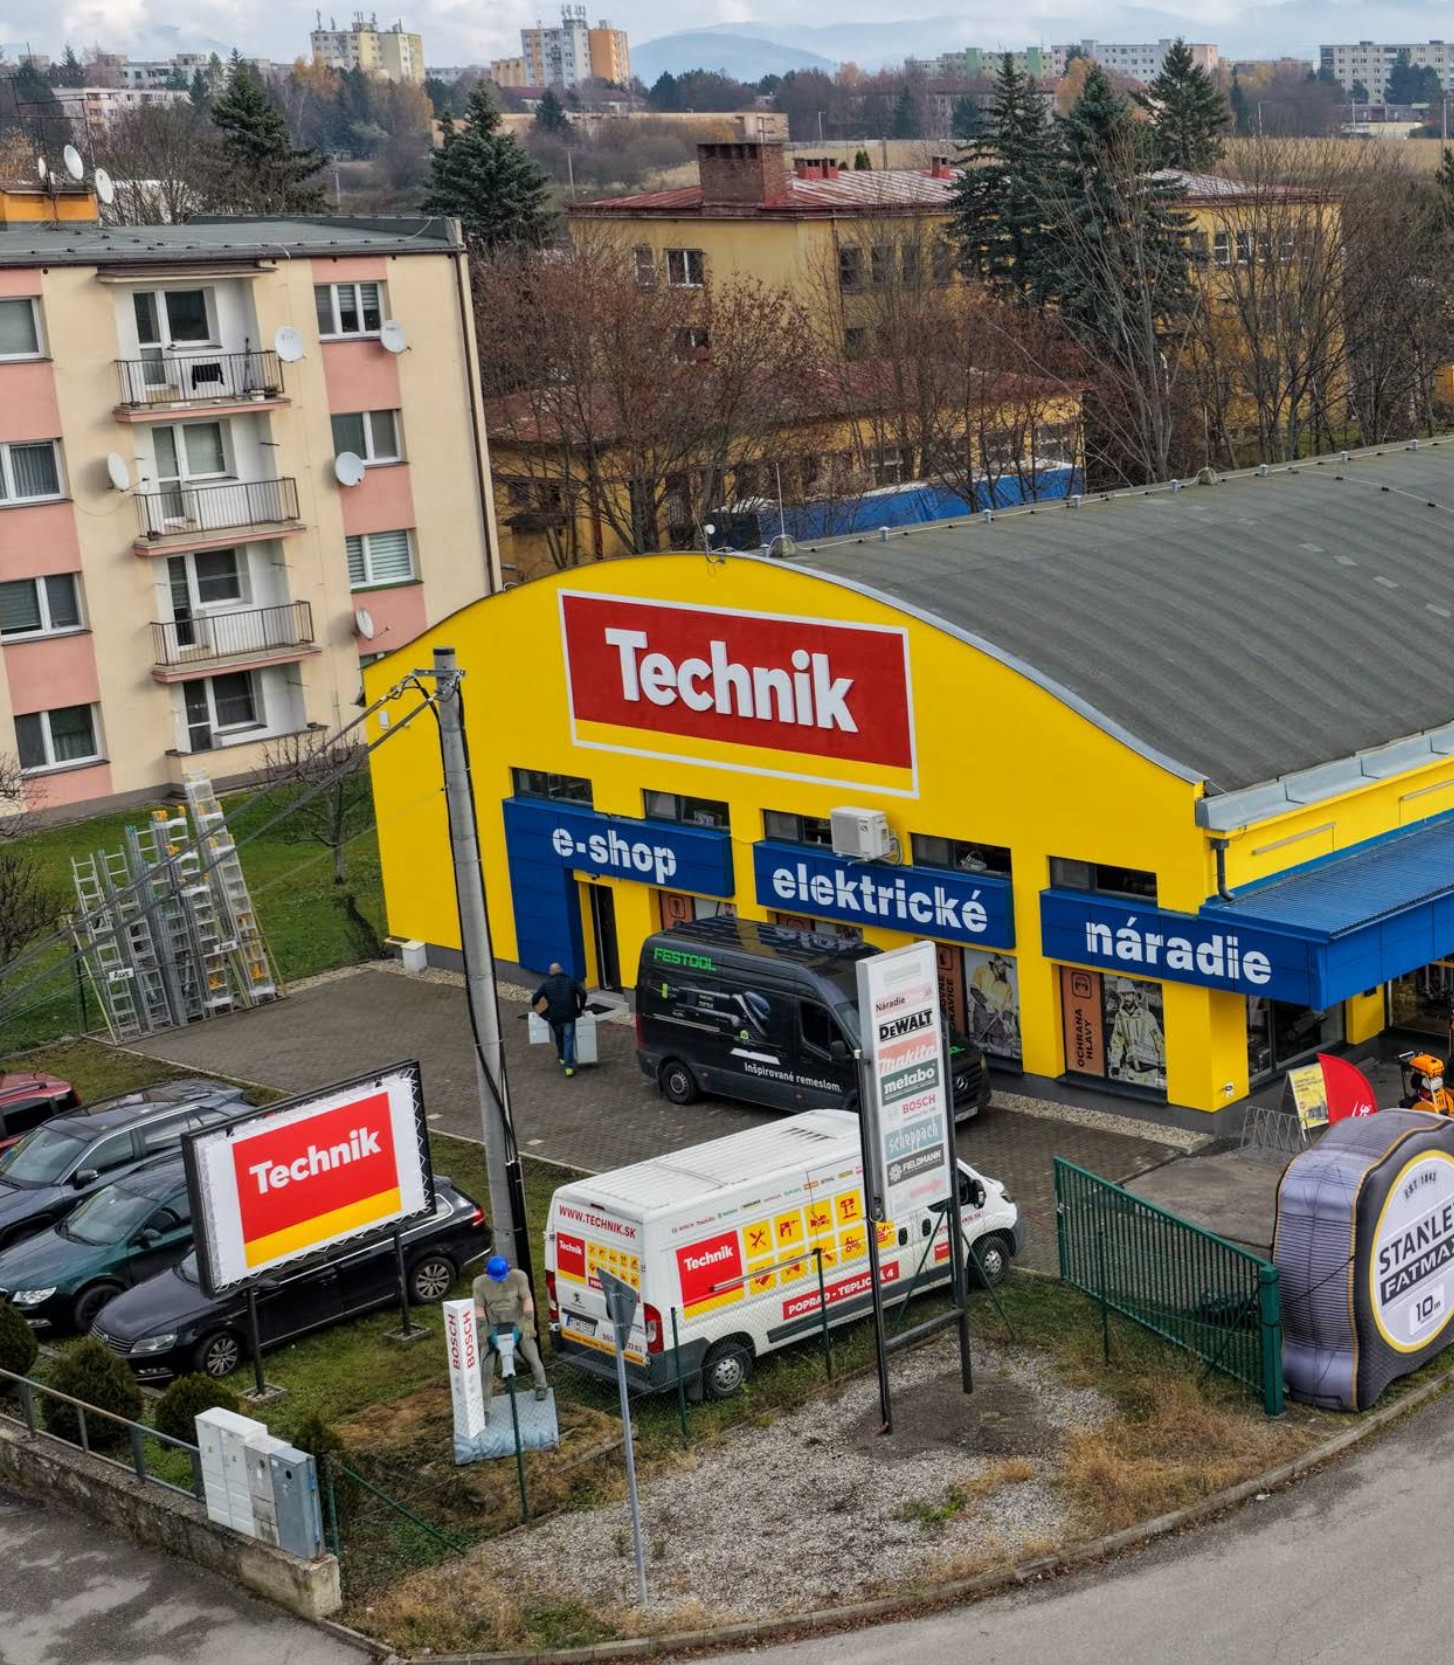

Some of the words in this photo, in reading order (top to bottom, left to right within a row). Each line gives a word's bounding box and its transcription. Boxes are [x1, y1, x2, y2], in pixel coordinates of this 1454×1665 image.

[605, 627, 859, 734] Technik
[553, 827, 677, 885] e-shop
[772, 863, 988, 933] elektrické
[654, 948, 718, 972] FESTOOL
[1086, 913, 1272, 986] náradie
[1073, 1008, 1085, 1067] OCHRANA
[1083, 1019, 1094, 1060] HLAVY
[744, 1062, 794, 1083] Inšpirované
[884, 1067, 936, 1094] metabo
[902, 1093, 936, 1114] BOSCH
[889, 1116, 939, 1153] scheppach
[248, 1127, 382, 1195] Technik
[903, 1150, 942, 1171] FIELDMANN
[558, 1204, 637, 1240] WWW.TECHNIK.SK
[559, 1240, 583, 1256] Technik
[684, 1245, 734, 1271] Technik
[449, 1313, 461, 1370] BOSCH
[463, 1310, 475, 1368] BOSCH
